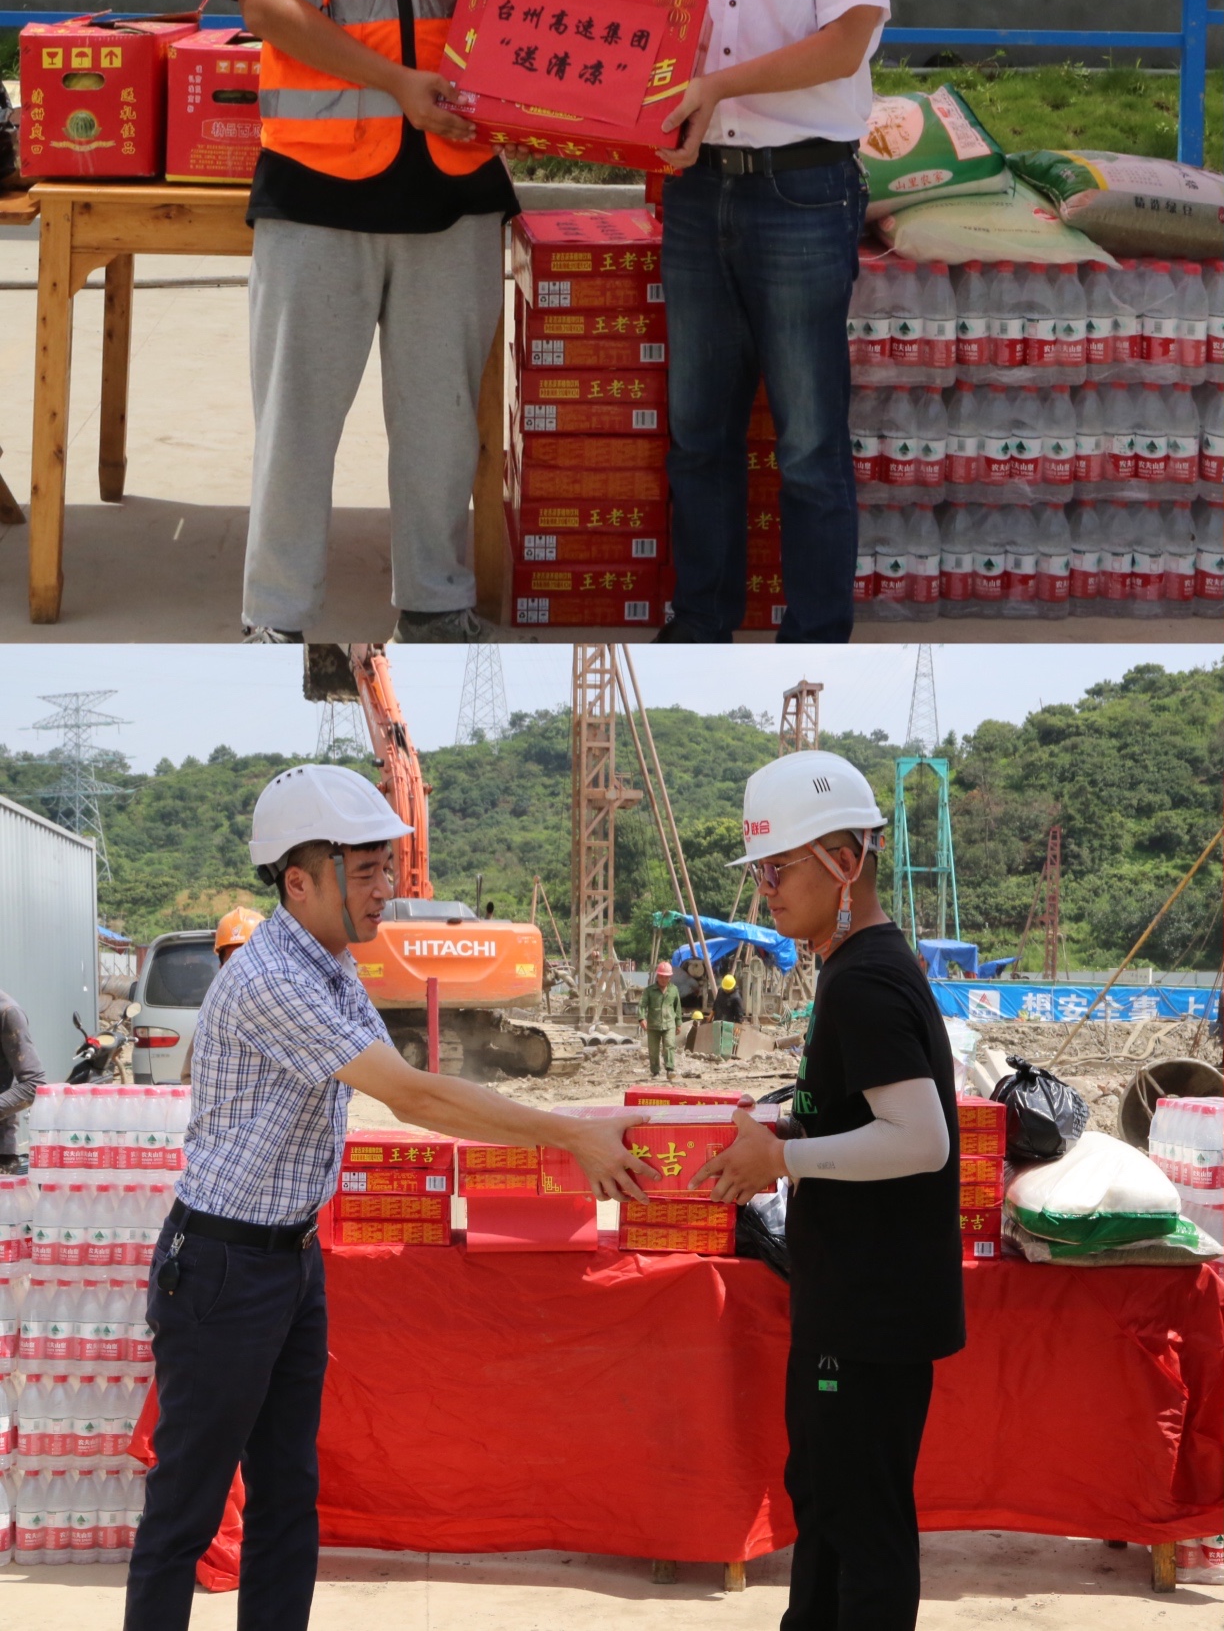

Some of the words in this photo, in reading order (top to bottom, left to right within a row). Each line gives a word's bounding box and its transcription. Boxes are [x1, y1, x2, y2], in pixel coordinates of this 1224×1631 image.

[489, 131, 587, 157] 王老吉
[895, 170, 944, 191] 山里农家
[600, 251, 658, 272] 王老吉
[592, 314, 650, 335] 王老吉
[586, 379, 645, 400] 王老吉
[586, 507, 644, 529] 王老吉
[579, 571, 637, 591] 王老吉
[403, 939, 496, 958] HITACHI
[389, 1146, 436, 1163] 王老吉
